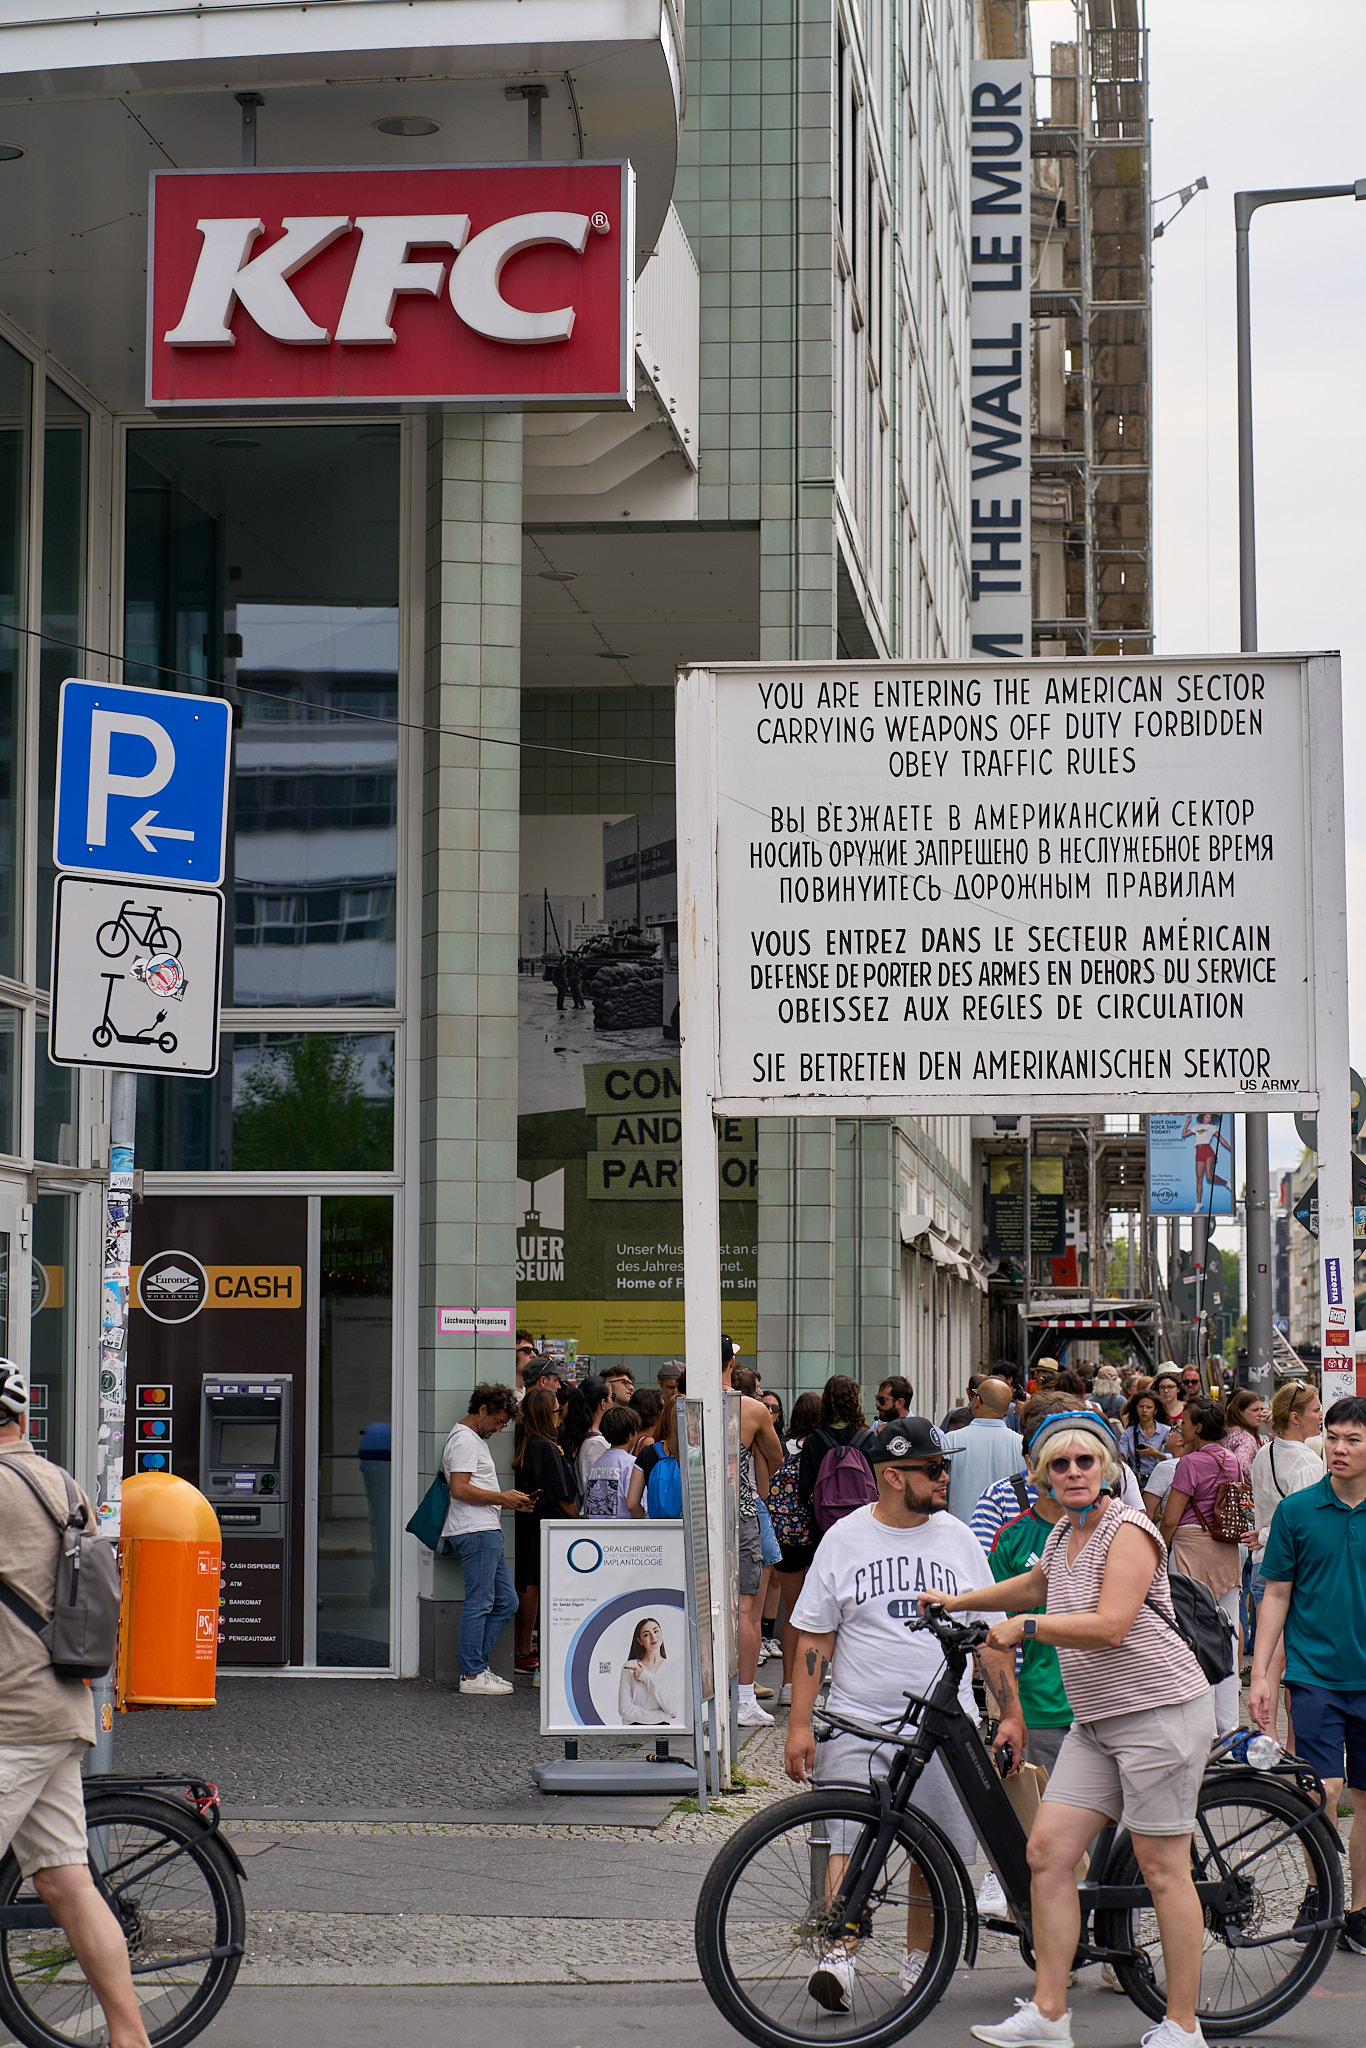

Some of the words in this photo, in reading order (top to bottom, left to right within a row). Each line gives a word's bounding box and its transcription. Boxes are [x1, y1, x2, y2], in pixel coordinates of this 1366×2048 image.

[971, 82, 1023, 215] MUR
[971, 236, 1022, 291] LE
[163, 211, 591, 347] KFC
[971, 323, 1022, 481] WALL
[971, 499, 1022, 601] THE
[758, 683, 802, 709] YOU
[817, 682, 858, 708] ARE
[875, 679, 980, 707] ENTERING
[993, 679, 1029, 705] THE
[1045, 676, 1161, 704] AMERICAN
[1177, 673, 1264, 702] SECTOR
[757, 717, 874, 744] CARRYING
[885, 715, 997, 742] WEAPONS
[1010, 714, 1050, 740] OFF
[1067, 712, 1121, 739] DUTY
[1136, 709, 1261, 737] FORBIDDEN
[890, 751, 948, 777] OBEY
[962, 749, 1052, 776] TRAFFIC
[1068, 747, 1135, 774] RULES
[86, 709, 176, 846] P
[772, 806, 804, 833] ВЫ
[949, 805, 960, 830] В
[975, 797, 1158, 830] АМЕРИКАНСКИЙ
[1172, 799, 1254, 826] СЕКТОР
[751, 841, 822, 868] НОСИТЬ
[830, 840, 907, 867] ОРУЖИЕ
[1039, 838, 1050, 864] В
[1061, 836, 1199, 863] НЕСЛУЖЕБНОЕ
[1210, 835, 1273, 861] ВРЕМЯ
[954, 873, 1089, 900] ДОРОЖНЫМ
[1107, 871, 1234, 898] ПРАВИЛАМ
[751, 929, 810, 956] VOUS
[827, 929, 906, 955] ENTREZ
[922, 927, 980, 953] DANS
[995, 927, 1013, 951] LE
[1028, 926, 1126, 952] SECTEUR
[1143, 917, 1269, 951] AMÉRICAIN
[751, 964, 829, 989] DEFENSE
[837, 964, 858, 988] DE
[864, 962, 931, 988] PORTER
[939, 961, 972, 986] DES
[979, 961, 1040, 986] ARMES
[1048, 961, 1071, 985] EN
[1081, 958, 1154, 984] DEHORS
[1165, 958, 1189, 983] DU
[1197, 958, 1276, 983] SERVICE
[779, 996, 888, 1023] OBEISSEZ
[904, 996, 949, 1021] AUX
[963, 994, 1042, 1020] REGLES
[1058, 995, 1082, 1019] DE
[1098, 993, 1242, 1019] CIRCULATION
[753, 1053, 785, 1082] SIE
[801, 1052, 905, 1081] BETRETEN
[920, 1052, 960, 1080] DEN
[973, 1049, 1170, 1079] AMERIKANISCHEN
[1184, 1048, 1270, 1078] SEKTOR
[1240, 1080, 1257, 1090] US
[1262, 1080, 1299, 1090] ARMY
[612, 1118, 682, 1145] AND
[718, 1119, 743, 1142] E
[603, 1160, 683, 1188] PAR
[516, 1236, 564, 1260] UER
[616, 1244, 654, 1255] Unser
[658, 1244, 684, 1255] Mus
[733, 1247, 748, 1255] an
[155, 1275, 190, 1284] Euronet
[516, 1261, 564, 1281] SEUM
[616, 1261, 640, 1271] des
[642, 1261, 684, 1272] Jahres
[215, 1276, 292, 1298] CASH
[616, 1278, 656, 1289] Home
[659, 1277, 674, 1289] of
[444, 1317, 507, 1326] Löschwassereinspeisung
[855, 1556, 958, 1606] CHICAGO
[199, 1615, 213, 1635] BSR
